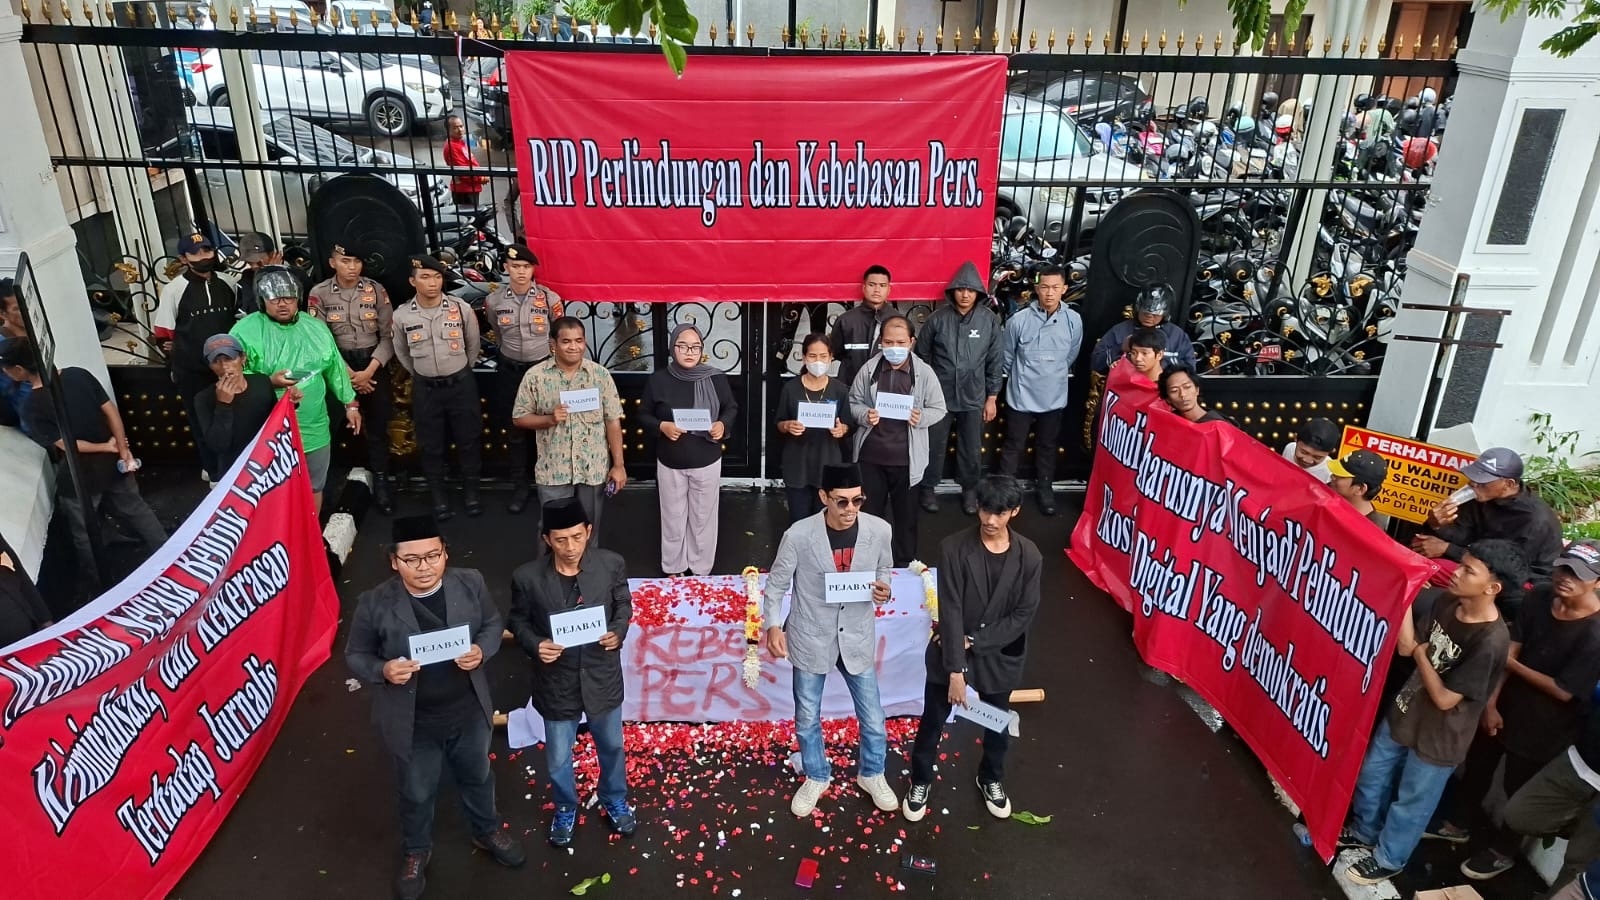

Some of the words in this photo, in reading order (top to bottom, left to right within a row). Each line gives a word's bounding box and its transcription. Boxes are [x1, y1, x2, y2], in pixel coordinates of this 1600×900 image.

[527, 138, 577, 207] RIP
[582, 138, 742, 227] Perlindungan
[748, 140, 792, 208] dan
[796, 140, 921, 209] Kebebasan
[927, 140, 983, 208] Pers.
[1392, 473, 1459, 497] SECURIT
[1407, 463, 1460, 485] WAJIB
[1393, 500, 1406, 509] DI
[829, 583, 872, 592] PEJABAT
[1290, 530, 1389, 694] Pelindung
[556, 619, 603, 636] PEJABAT
[414, 638, 466, 654] PEJABAT
[1130, 530, 1201, 620] Digital
[1194, 567, 1248, 671] Yang
[1241, 607, 1331, 759] demokratis.
[637, 662, 777, 722] PERS
[115, 740, 221, 866] Terhadap
[198, 654, 278, 763] Jurnalis
